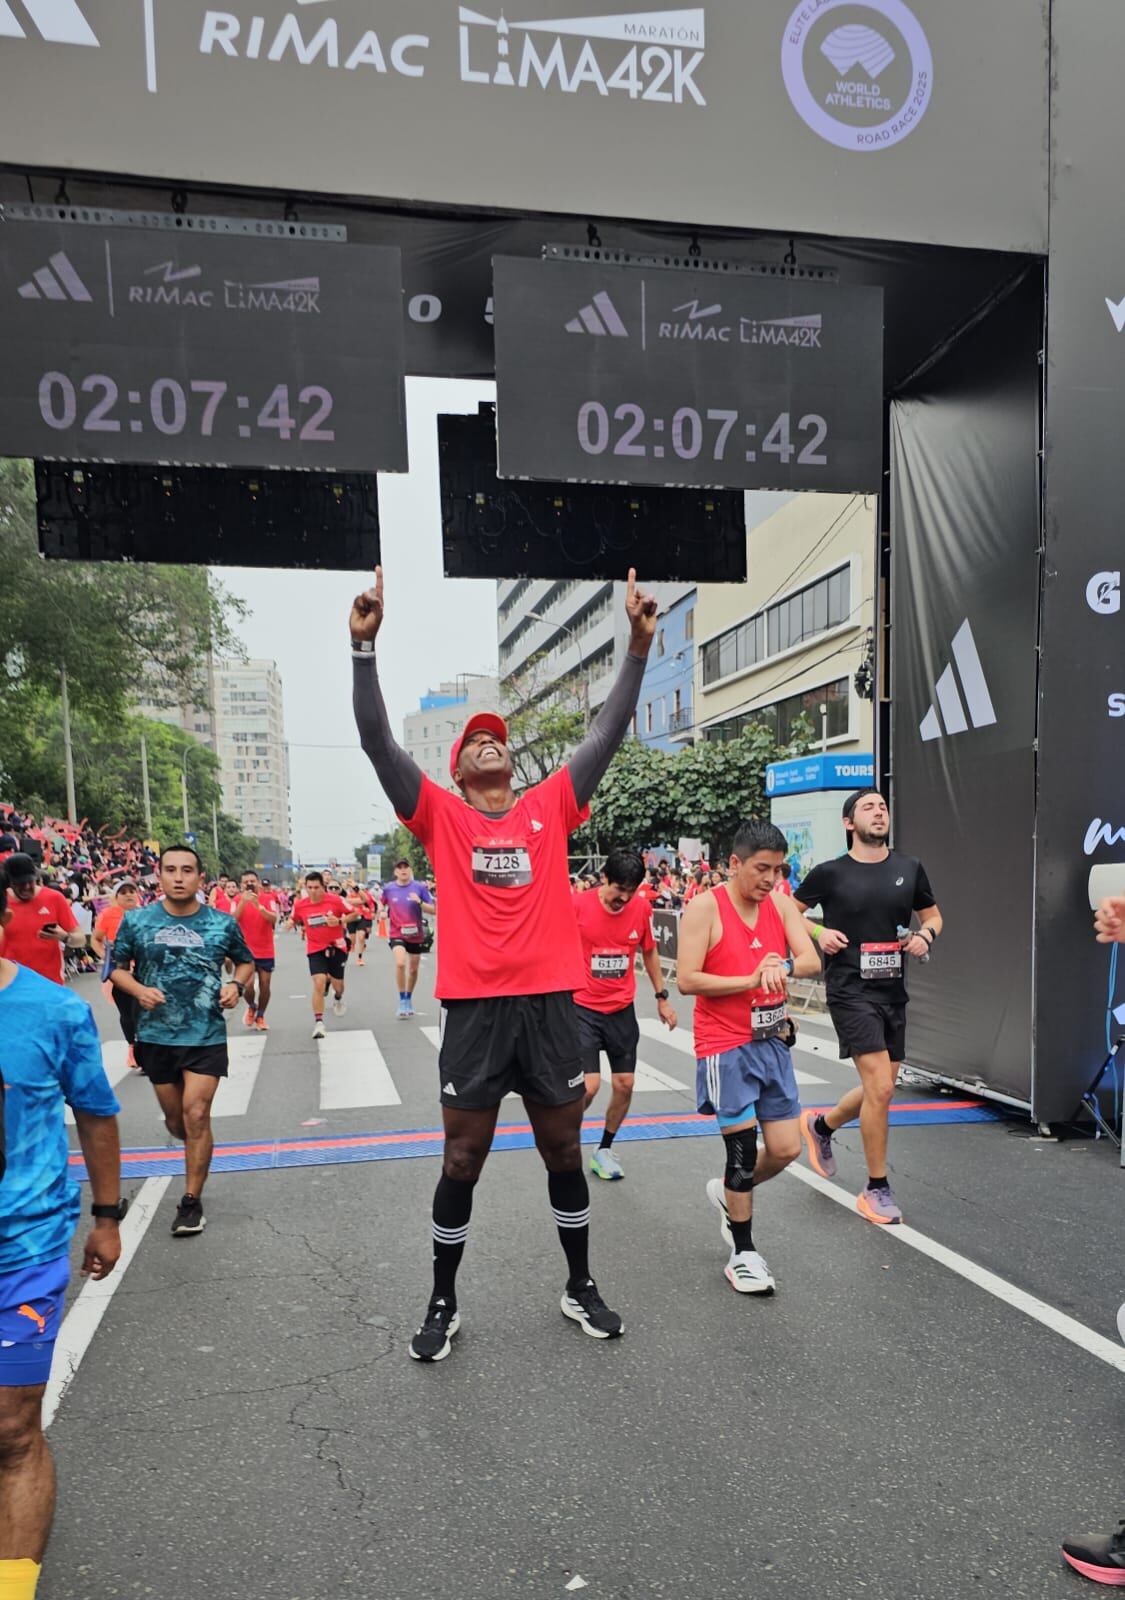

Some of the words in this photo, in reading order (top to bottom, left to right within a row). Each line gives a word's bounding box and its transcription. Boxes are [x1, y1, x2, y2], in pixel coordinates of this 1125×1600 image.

[624, 22, 700, 42] MARATÓN
[789, 11, 810, 45] ELITE
[200, 11, 429, 77] RIMAC
[836, 80, 880, 97] WORLD
[825, 92, 891, 110] ATHLETICS
[857, 130, 890, 144] ROAD
[891, 106, 917, 134] RACE
[914, 71, 927, 106] 2025
[129, 285, 214, 307] RIMAC
[658, 322, 731, 342] RIMAC
[38, 371, 335, 441] 02:07:42
[577, 401, 827, 465] 02:07:42
[483, 856, 520, 870] 7128
[598, 959, 624, 969] 6177
[868, 956, 896, 967] 6845
